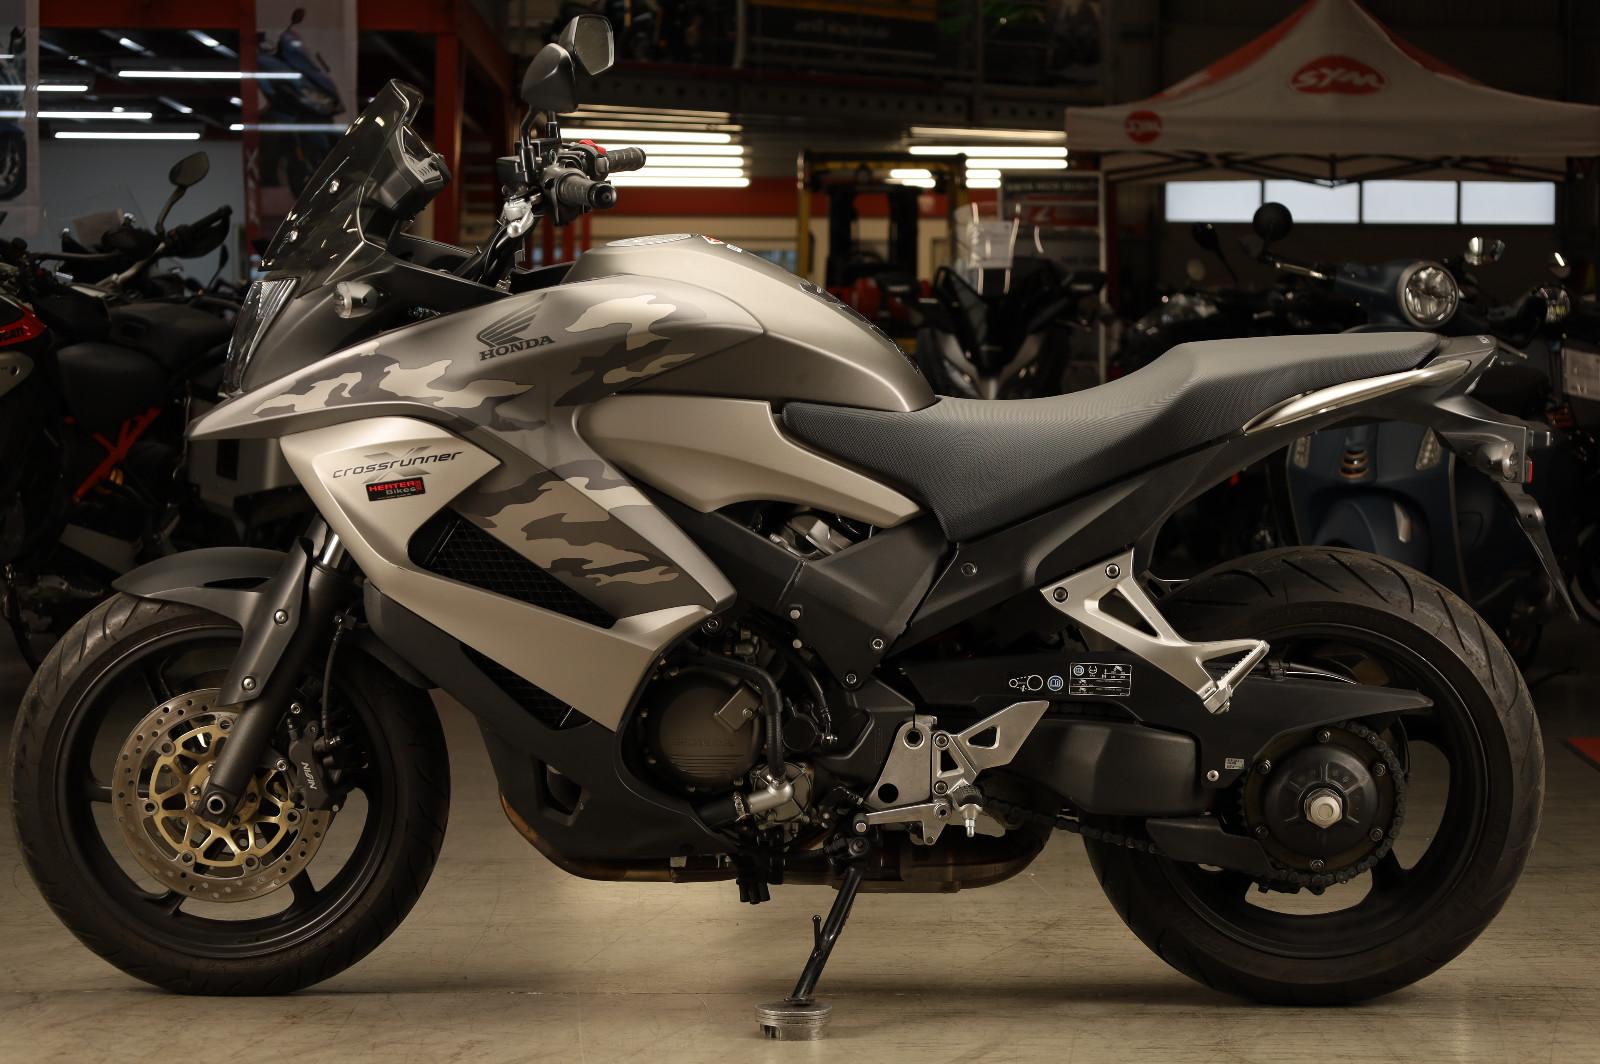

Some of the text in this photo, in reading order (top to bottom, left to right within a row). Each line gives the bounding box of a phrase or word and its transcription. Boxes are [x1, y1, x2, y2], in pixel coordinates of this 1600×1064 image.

[1294, 66, 1385, 88] SYM
[479, 335, 556, 361] HONDA
[332, 451, 464, 479] crossrunner
[386, 487, 416, 495] Bikes
